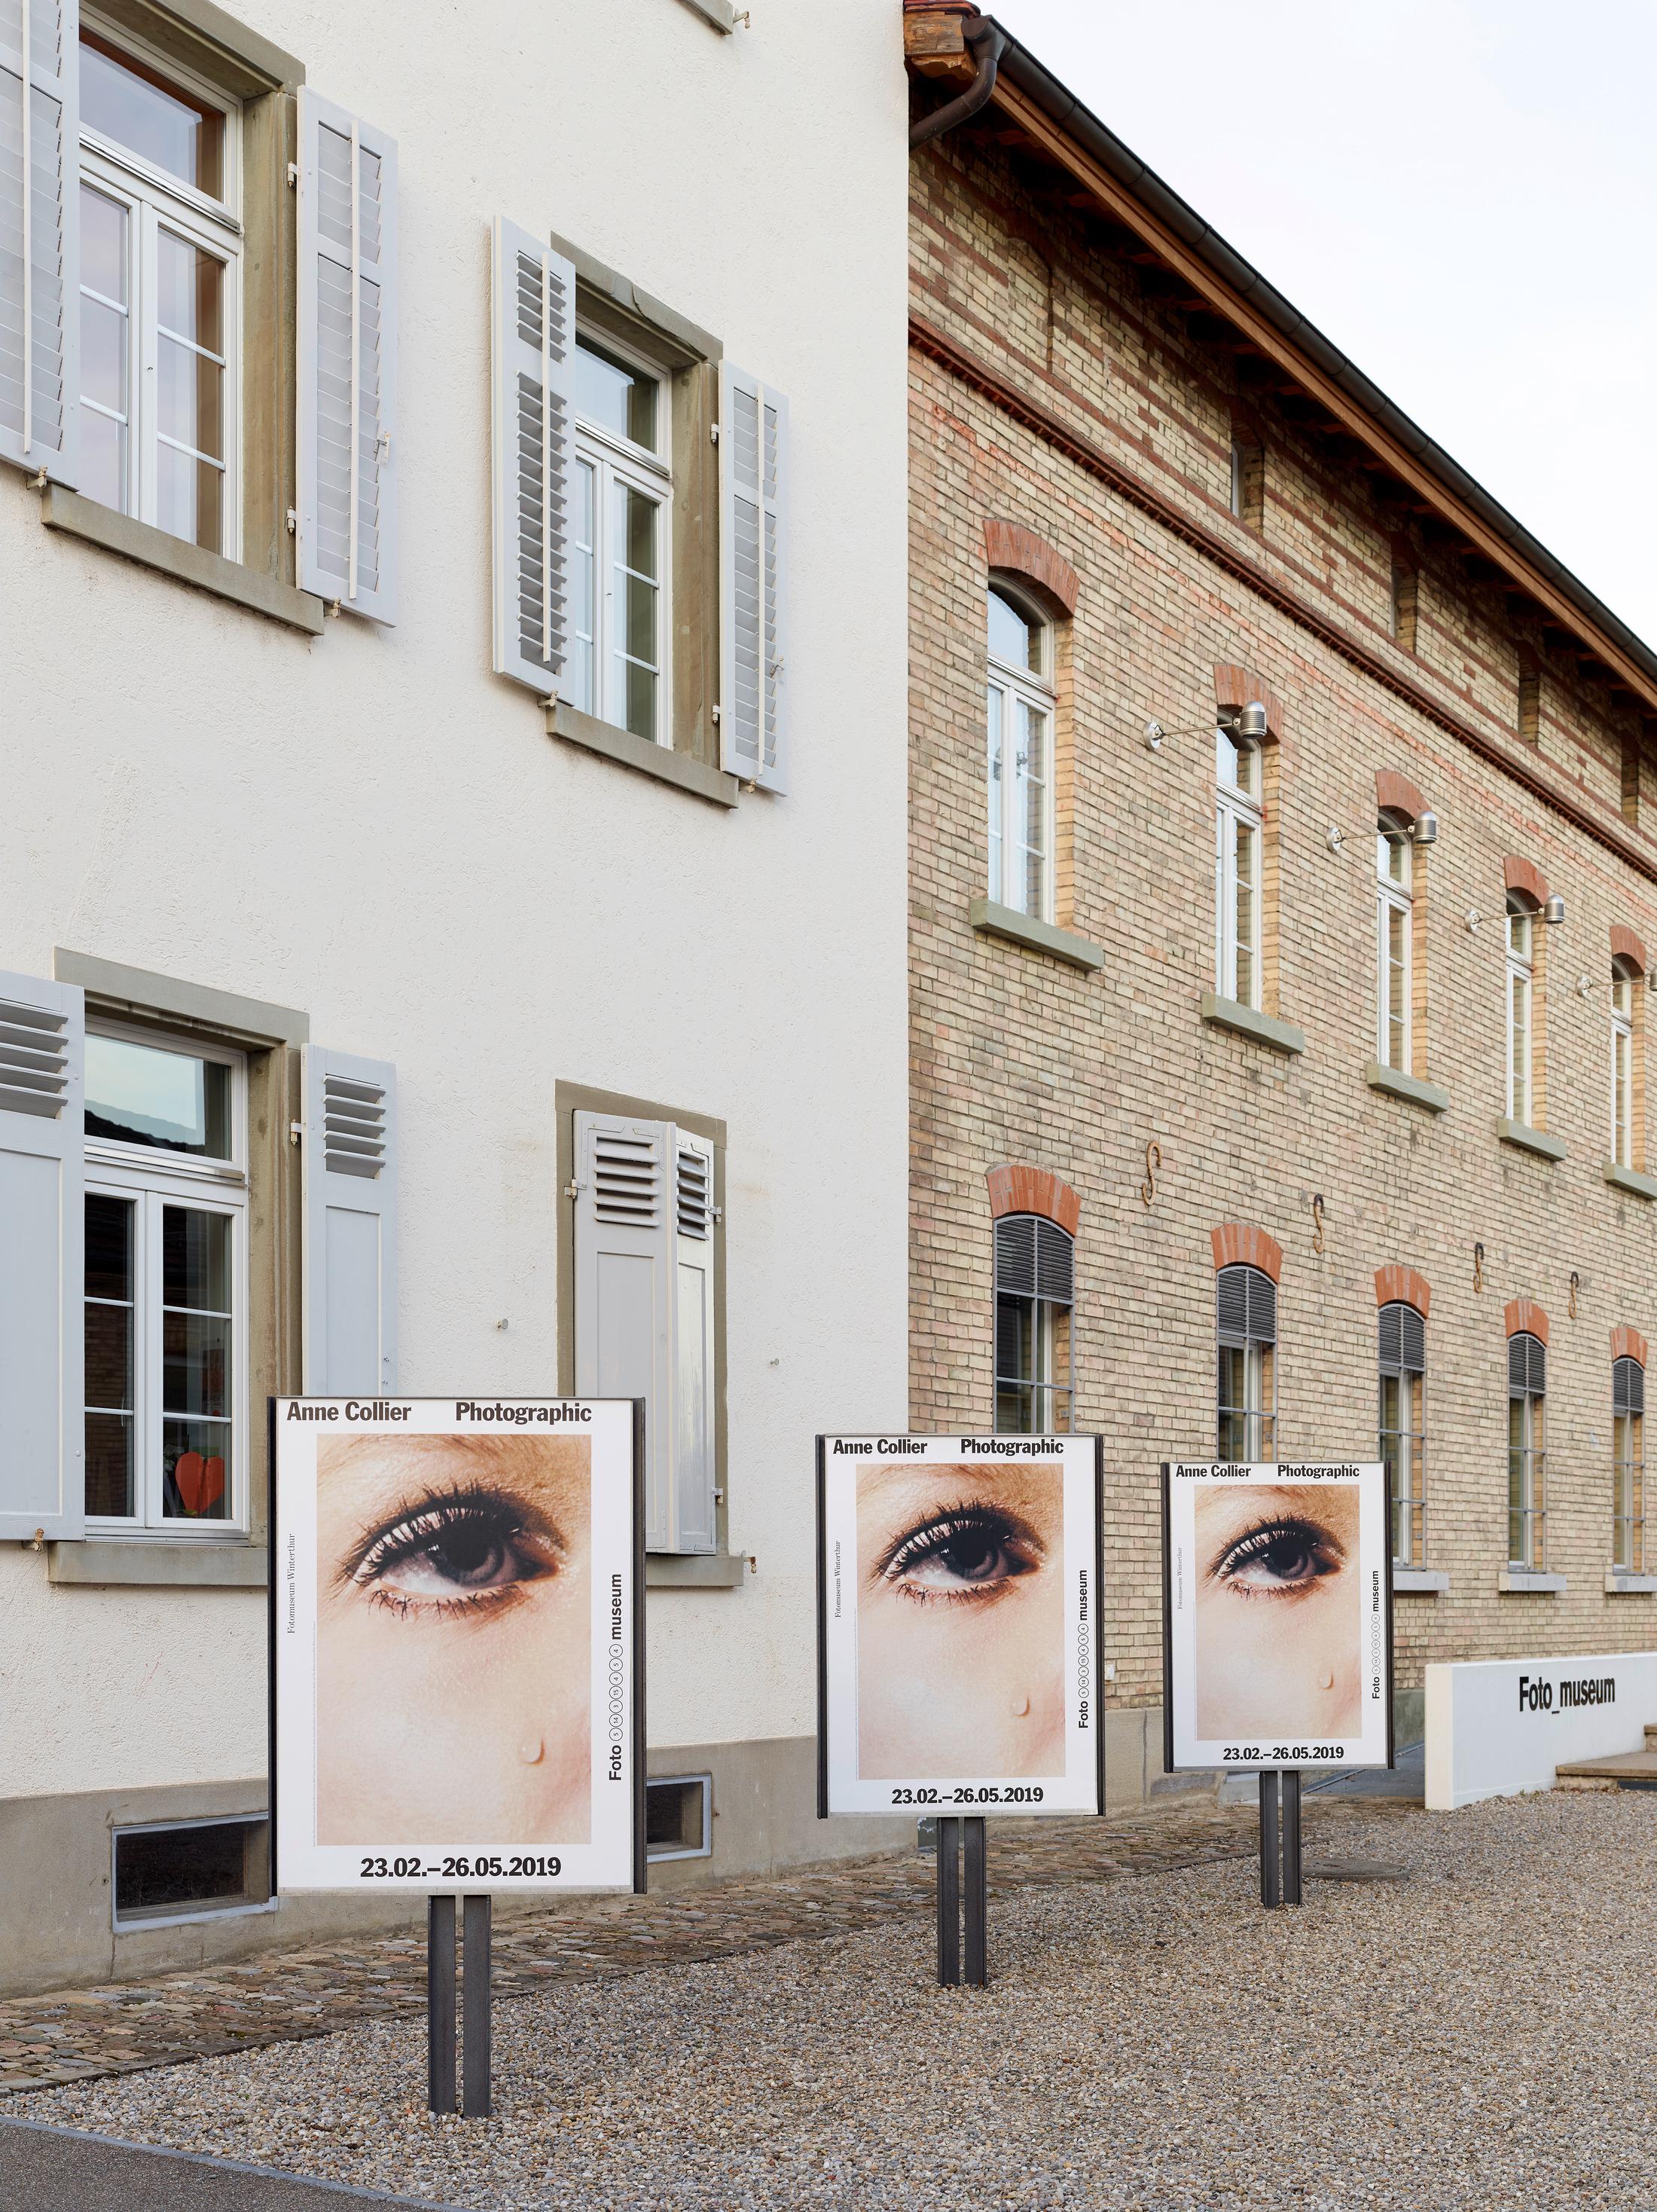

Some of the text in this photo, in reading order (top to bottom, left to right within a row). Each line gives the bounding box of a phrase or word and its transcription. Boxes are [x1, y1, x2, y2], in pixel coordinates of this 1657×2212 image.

[287, 1400, 592, 1425] Anne Collier Photographic
[833, 1438, 1064, 1456] Anne Collier Photographic
[1176, 1465, 1360, 1479] Anne Collier Photographic
[288, 1533, 296, 1634] Fotomuseum Winterthur
[1079, 1569, 1088, 1621] museum
[612, 1574, 622, 1640] museum
[1372, 1676, 1381, 1699] Foto
[1519, 1676, 1616, 1714] Foto_museum
[1079, 1700, 1089, 1728] Foto
[609, 1745, 622, 1781] Foto
[1222, 1746, 1344, 1761] 23.02.–26.05.2019
[892, 1787, 1044, 1804] 23.02.–26.05.2019
[361, 1857, 561, 1877] 23.02.–26.05.2019
